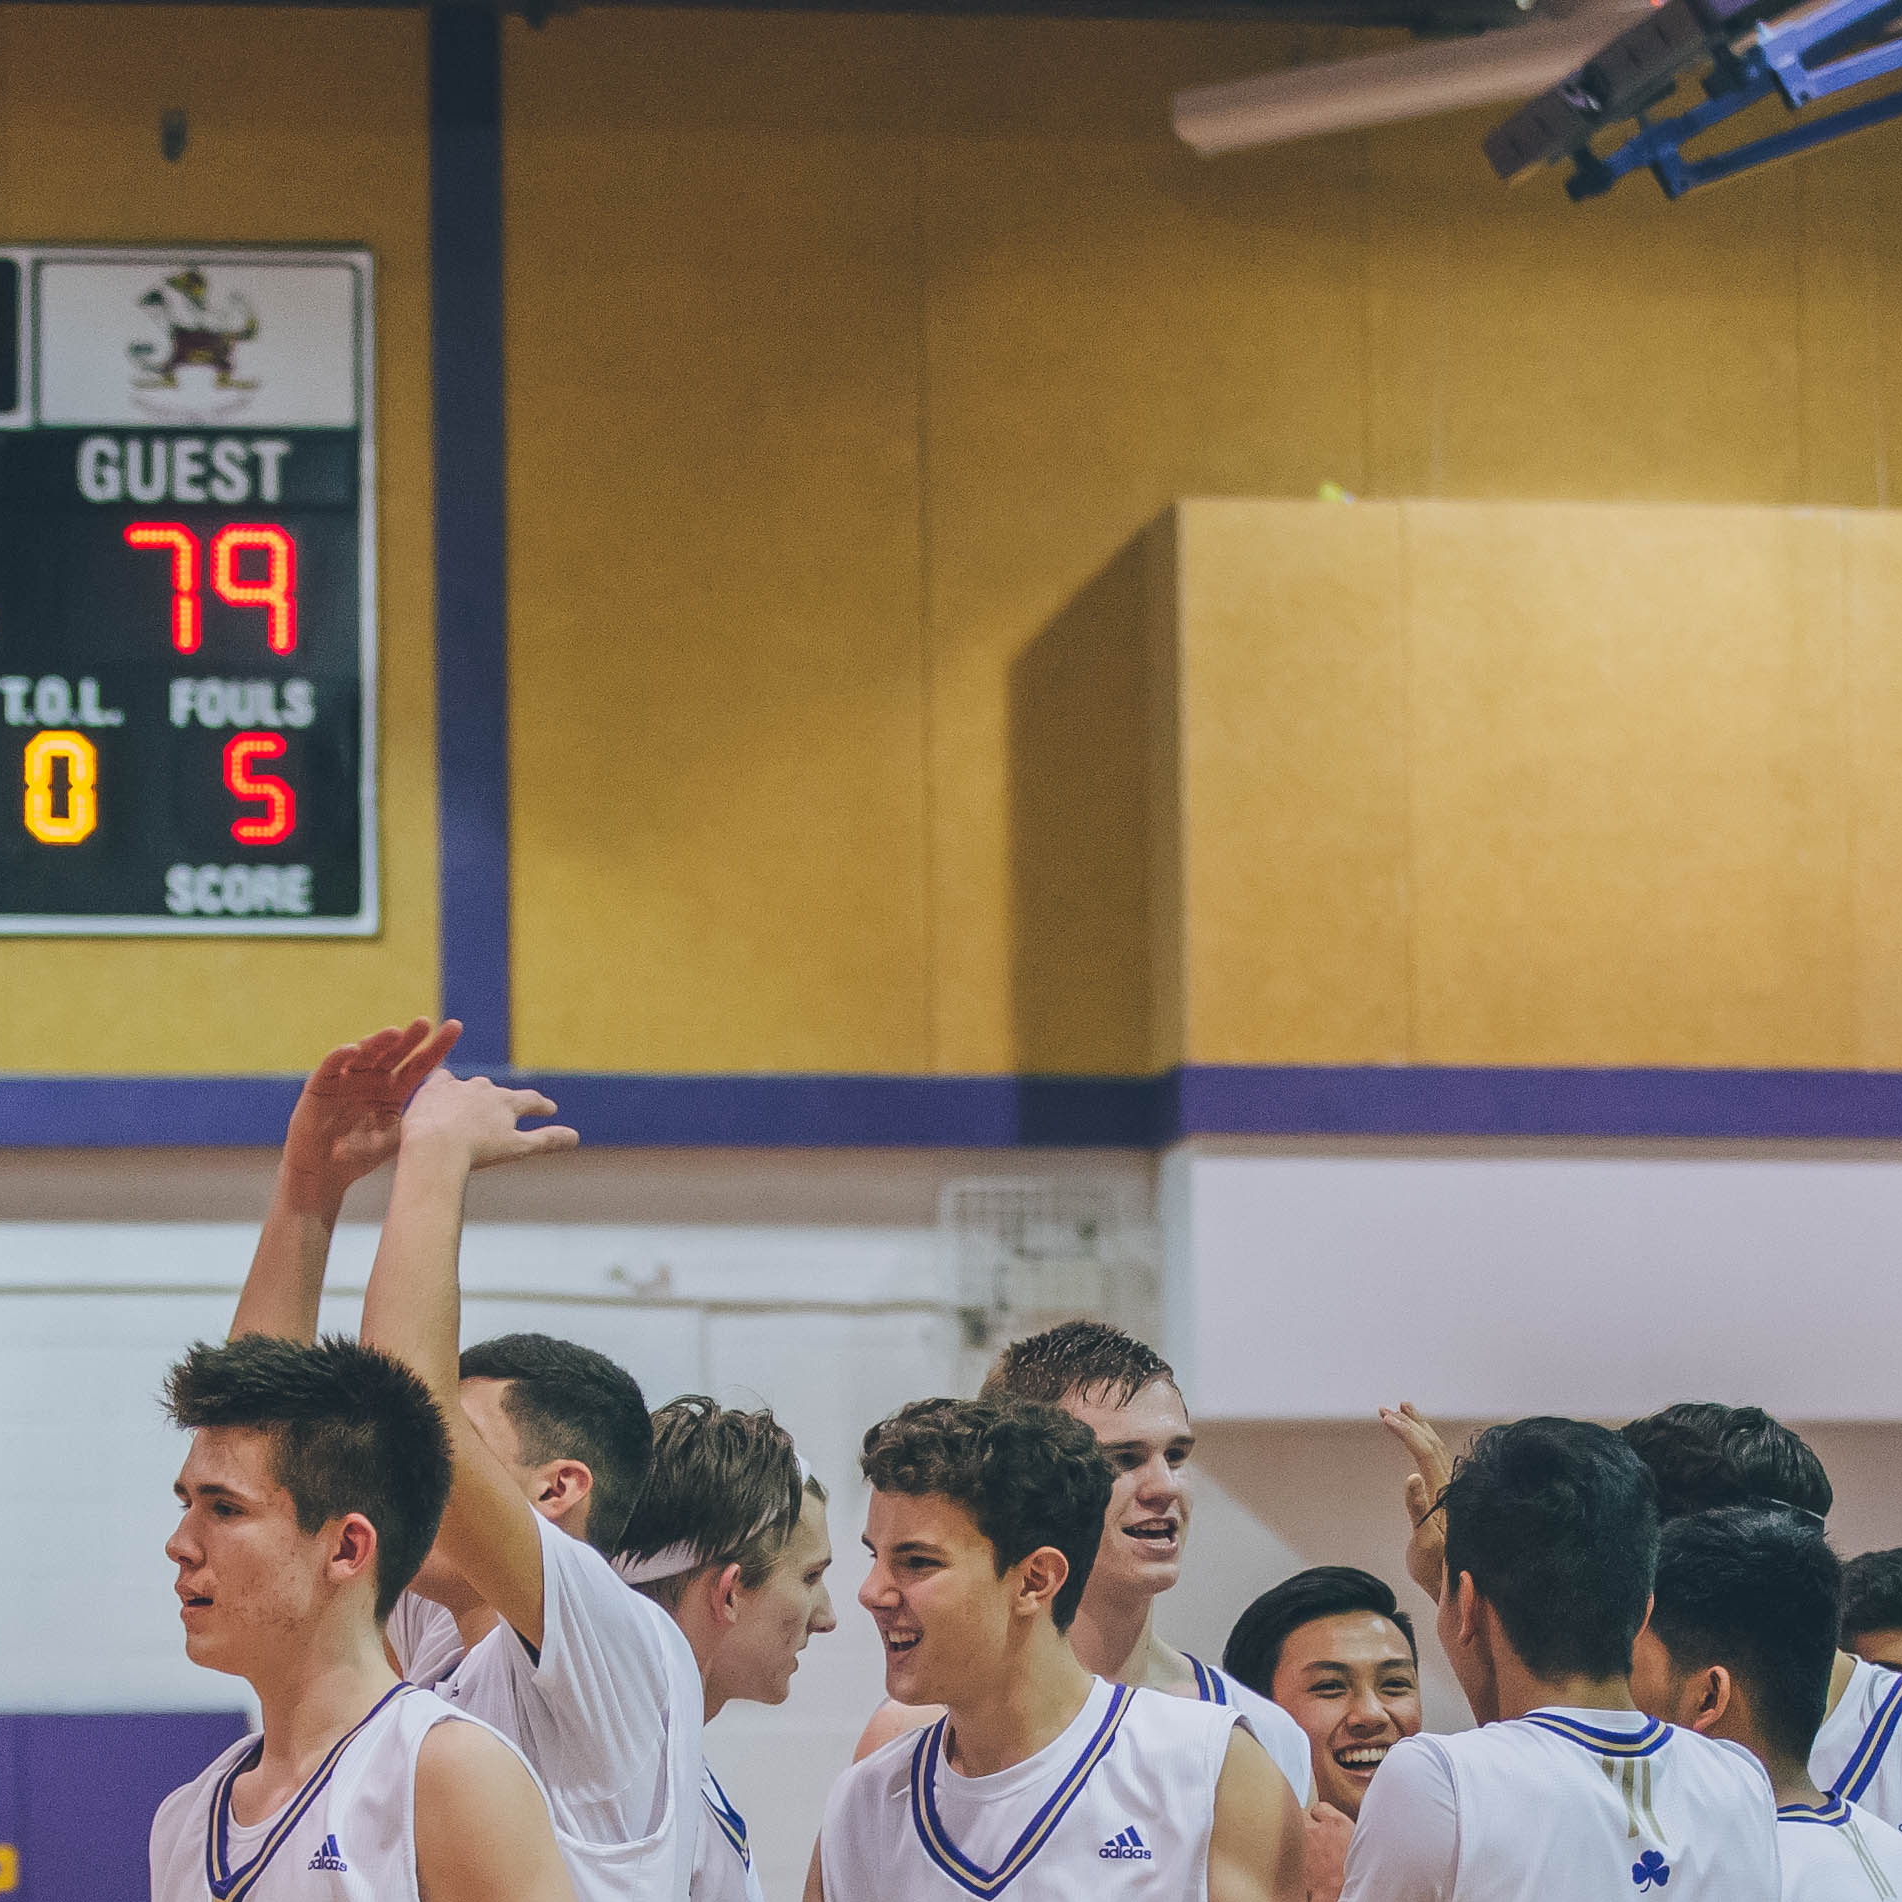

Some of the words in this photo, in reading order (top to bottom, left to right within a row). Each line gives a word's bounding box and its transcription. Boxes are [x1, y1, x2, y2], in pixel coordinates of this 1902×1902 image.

[77, 436, 291, 503] GUEST
[123, 522, 296, 655] 79
[169, 676, 315, 729] FOULS
[23, 730, 97, 845] 0
[223, 731, 296, 845] 5
[164, 863, 312, 915] SCORE
[307, 1855, 347, 1872] adidas
[1098, 1845, 1152, 1860] adidas
